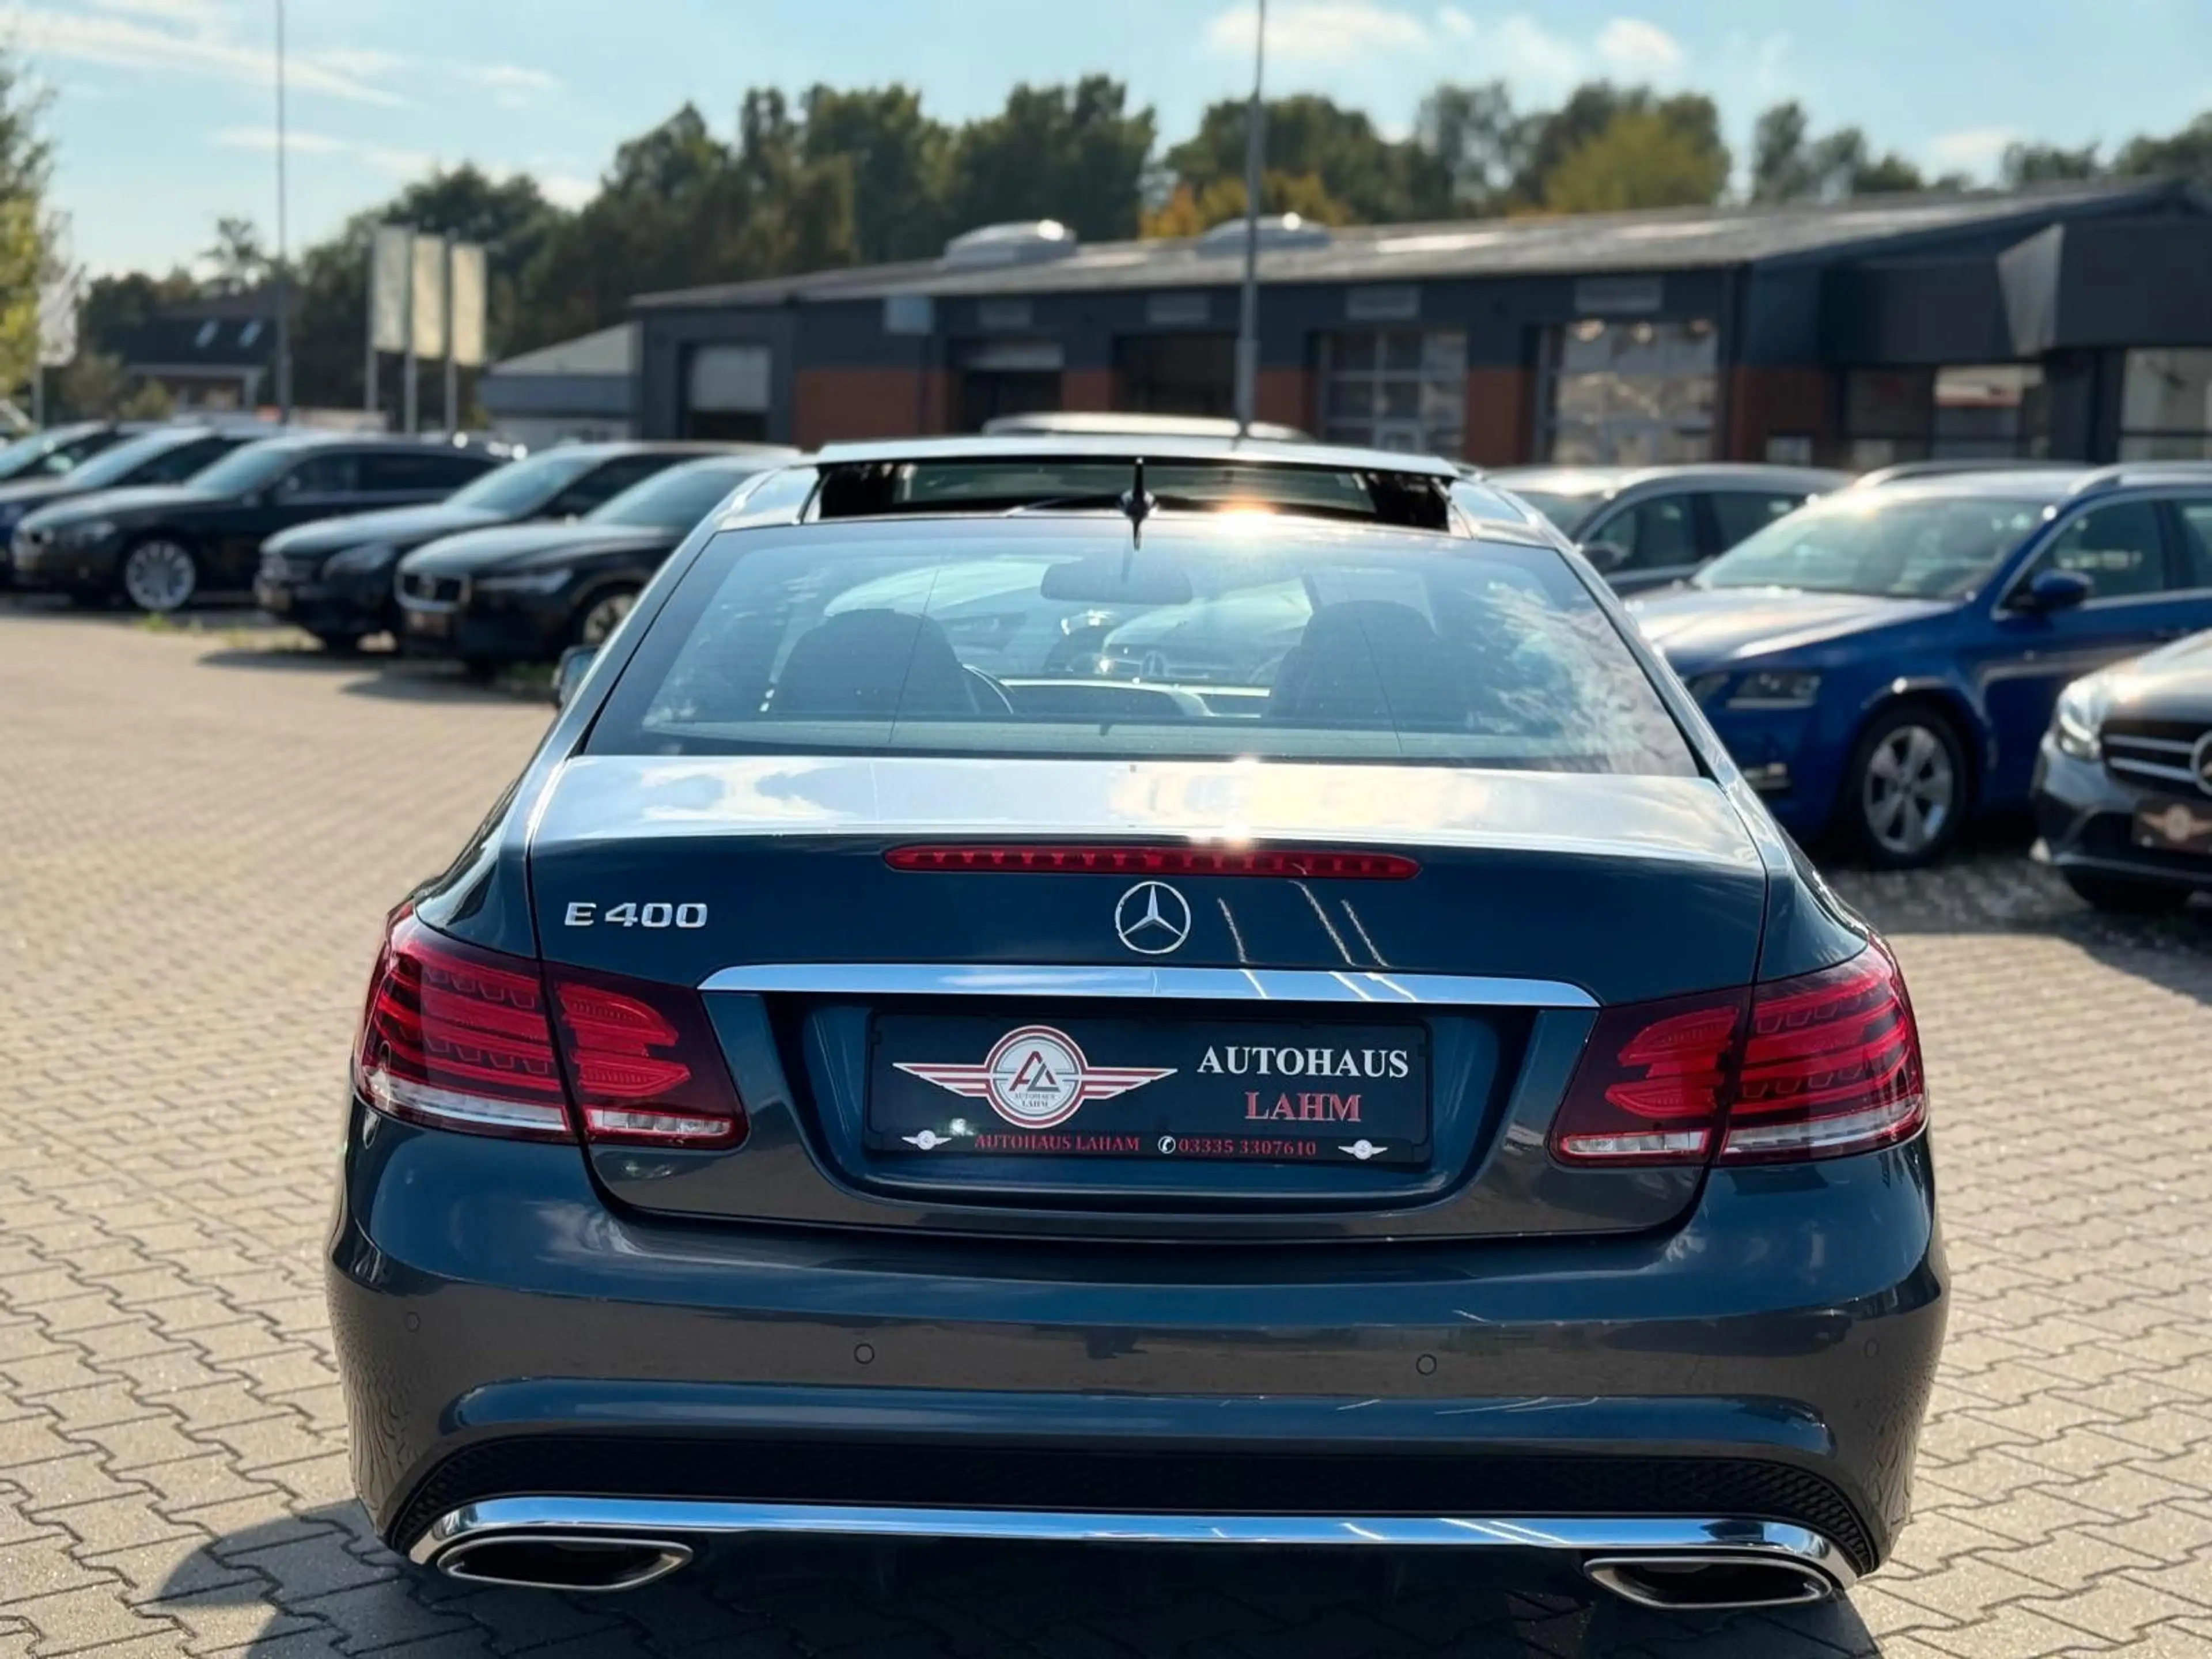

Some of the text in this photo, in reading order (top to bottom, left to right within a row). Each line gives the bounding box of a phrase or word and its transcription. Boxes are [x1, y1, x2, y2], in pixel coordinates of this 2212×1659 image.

[564, 902, 708, 928] E 400
[1197, 1046, 1409, 1078] AUTOHAUS
[1245, 1092, 1362, 1122] LAHM
[975, 1134, 1071, 1150] AUTOHAUS
[1179, 1138, 1316, 1156] 03335 3307610
